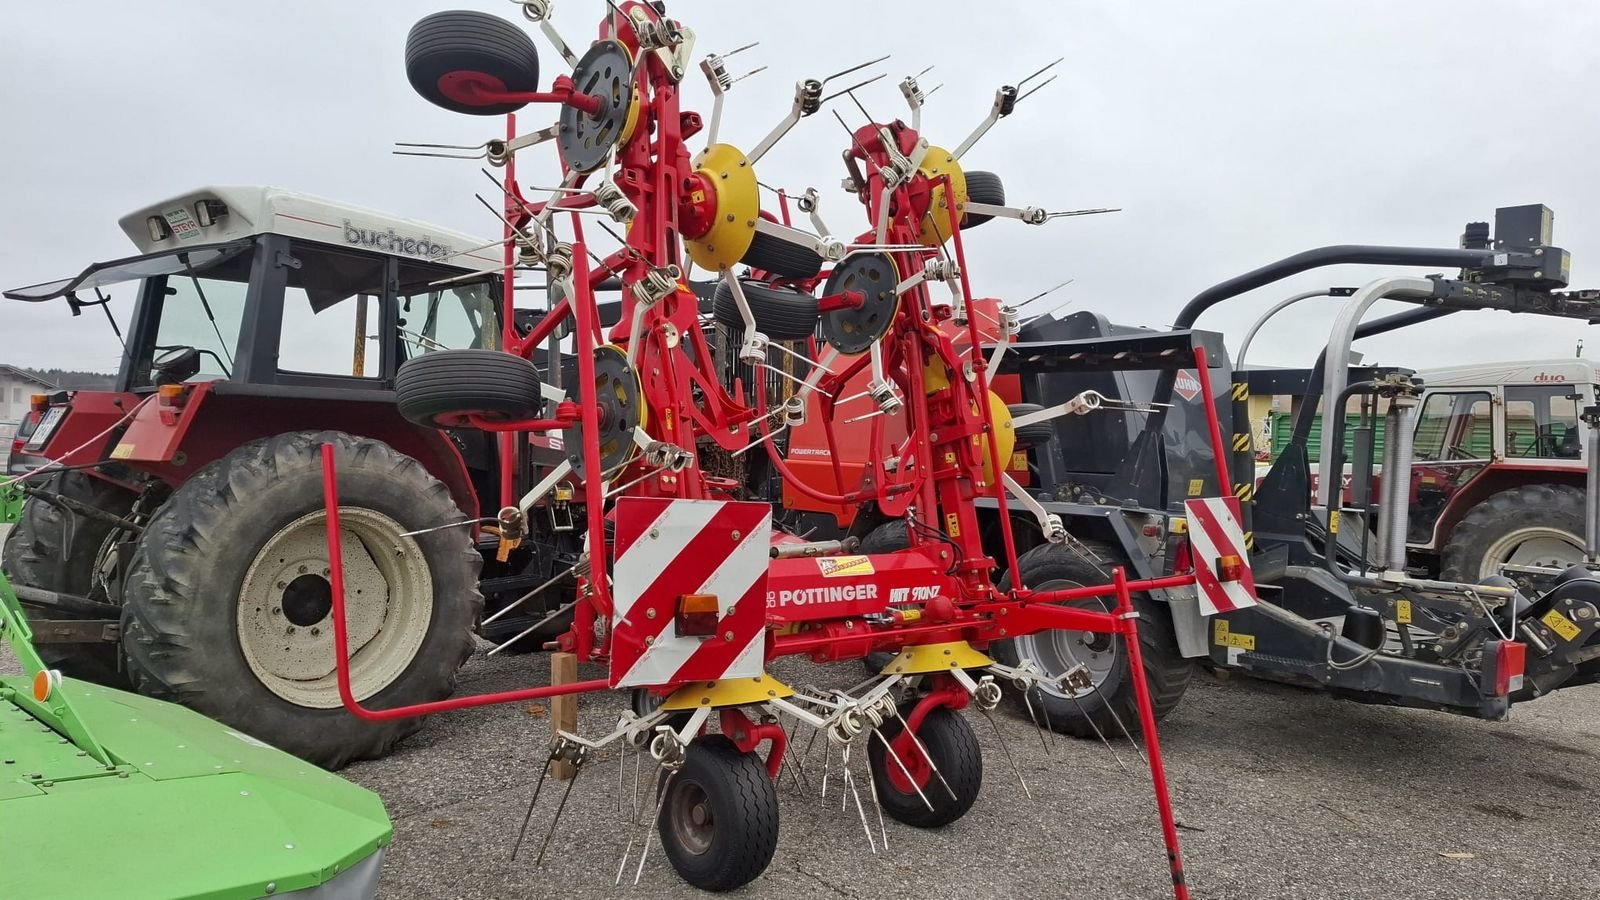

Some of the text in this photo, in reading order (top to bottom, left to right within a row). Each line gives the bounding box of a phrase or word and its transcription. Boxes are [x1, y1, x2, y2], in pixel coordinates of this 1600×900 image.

[172, 221, 197, 234] STEYR
[1534, 372, 1565, 382] duo
[779, 584, 878, 607] PÖTTINGER
